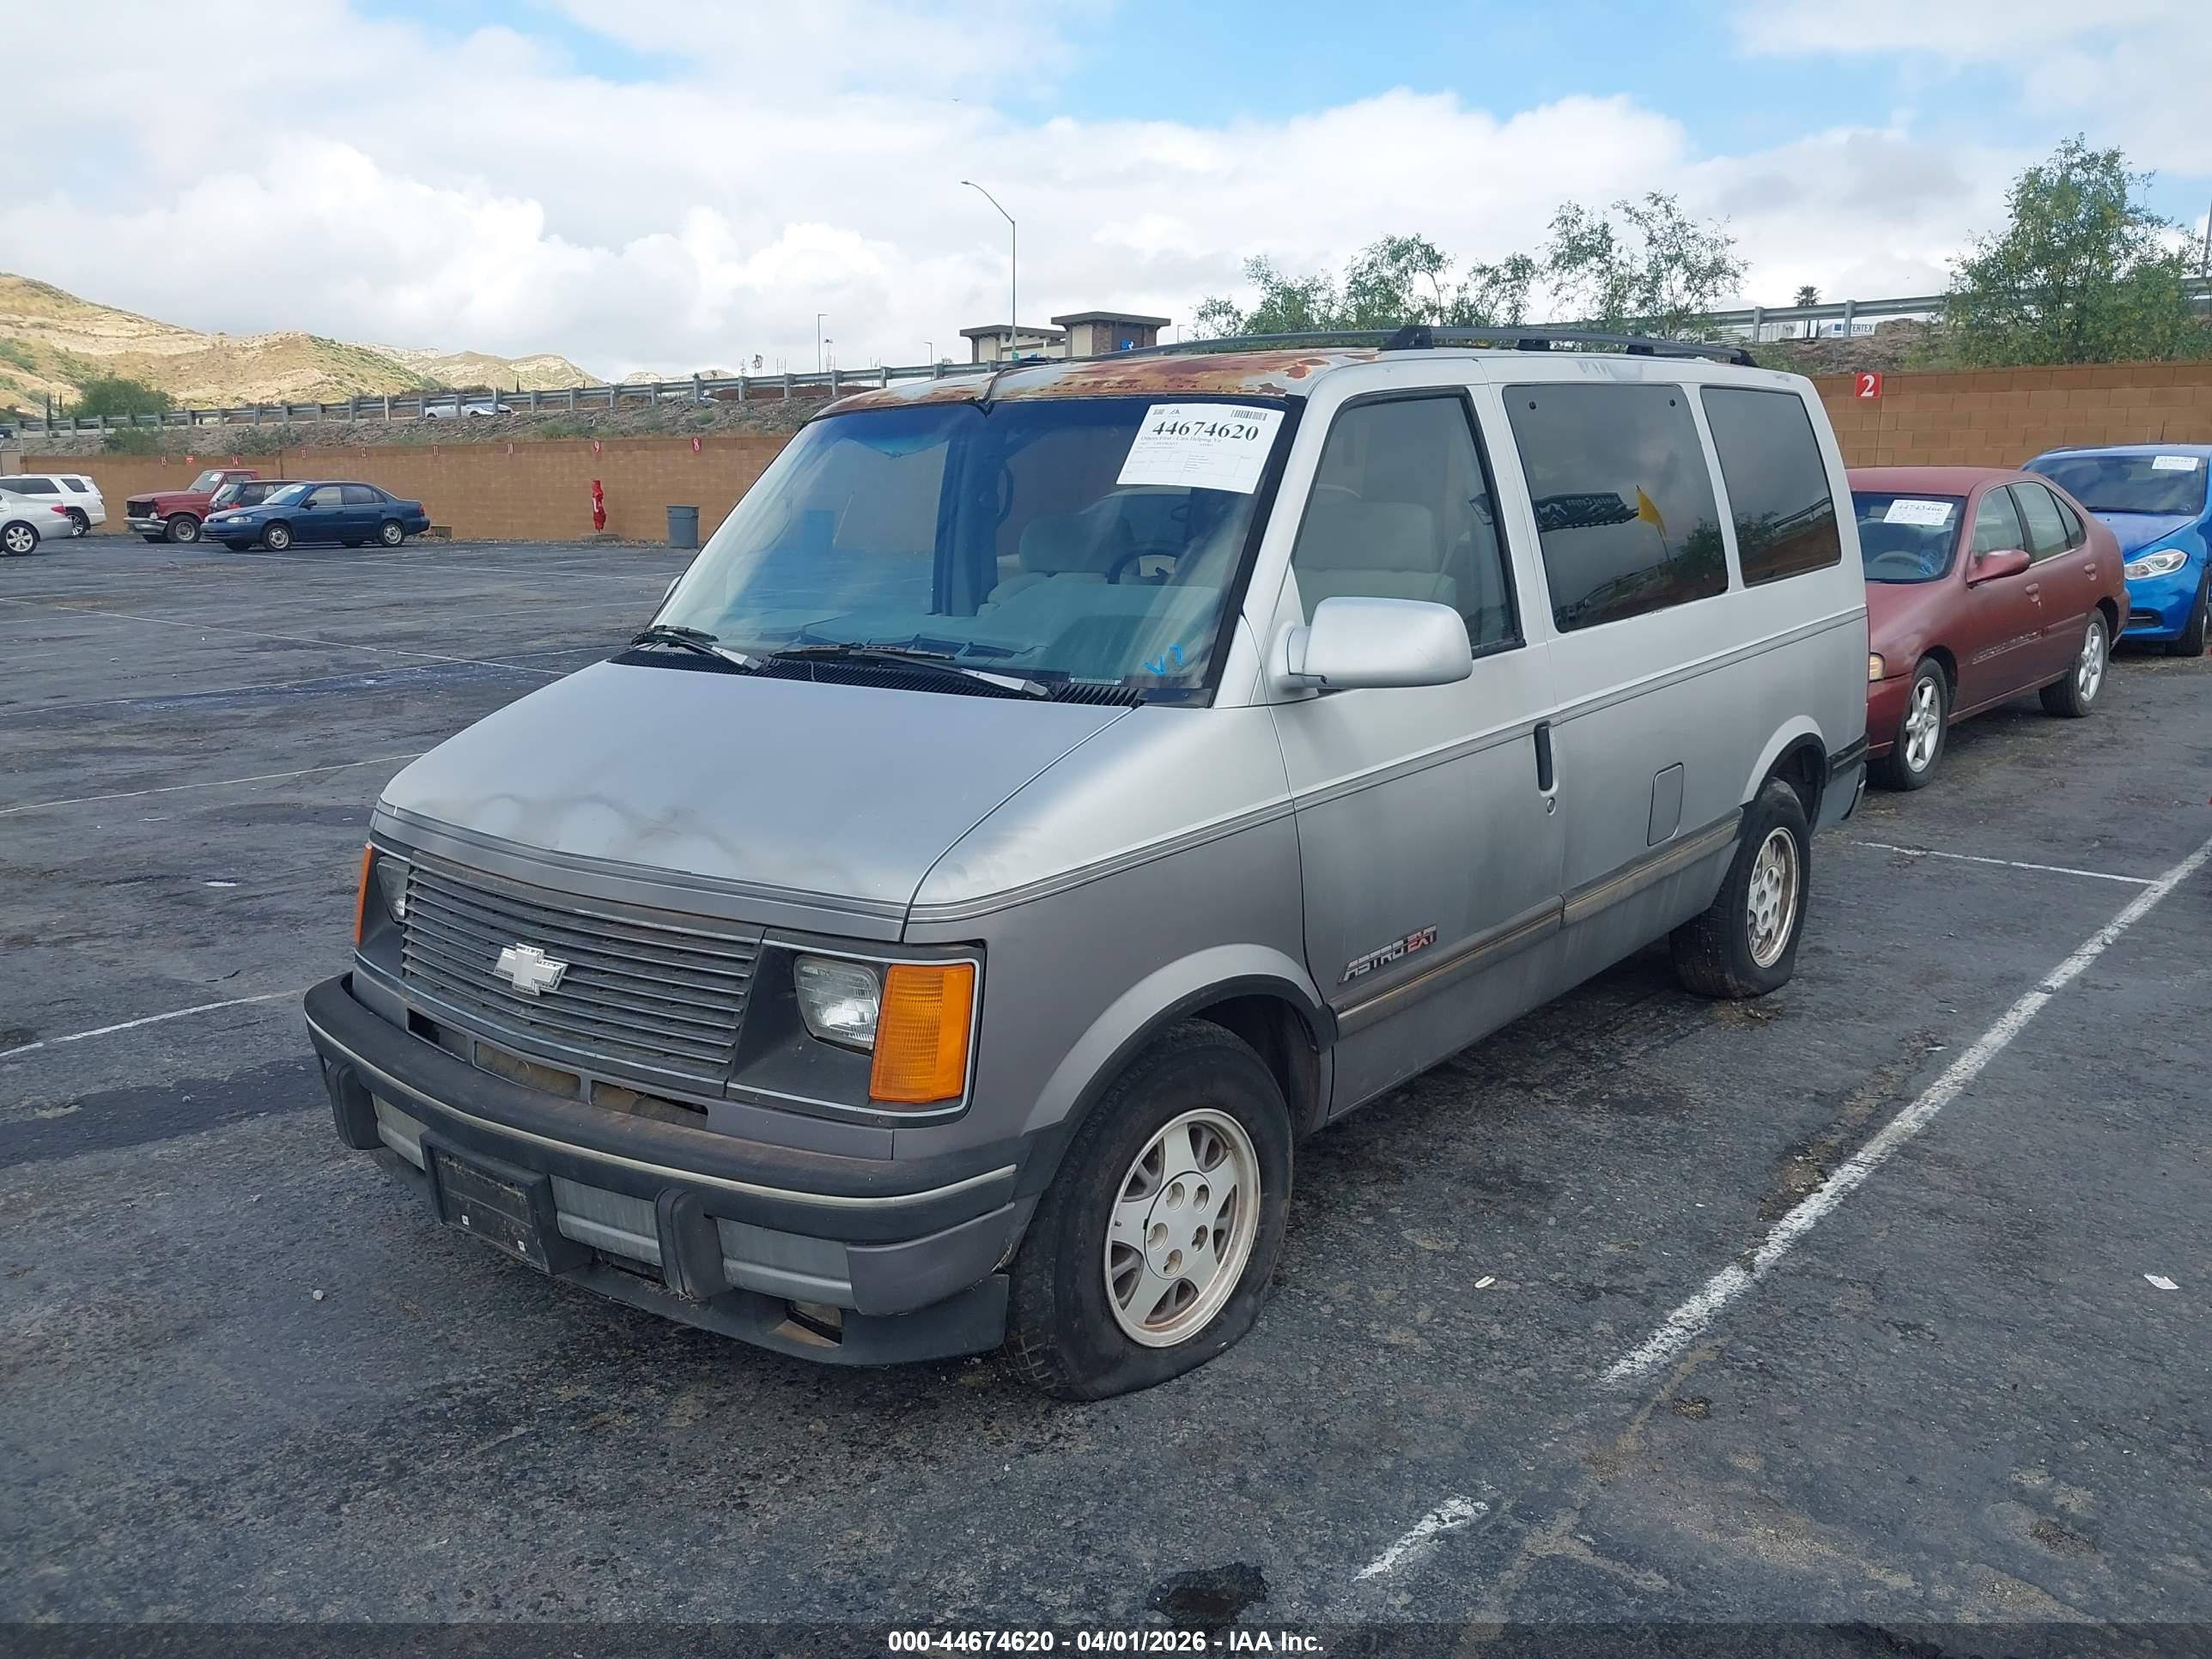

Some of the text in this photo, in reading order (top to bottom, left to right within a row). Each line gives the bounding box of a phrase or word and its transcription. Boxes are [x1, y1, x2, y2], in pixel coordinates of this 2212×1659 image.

[1860, 374, 1875, 398] 2
[1152, 420, 1259, 441] 44674620
[594, 441, 599, 453] 9
[693, 438, 700, 451] 8
[1340, 925, 1437, 981] ASTRO EXT
